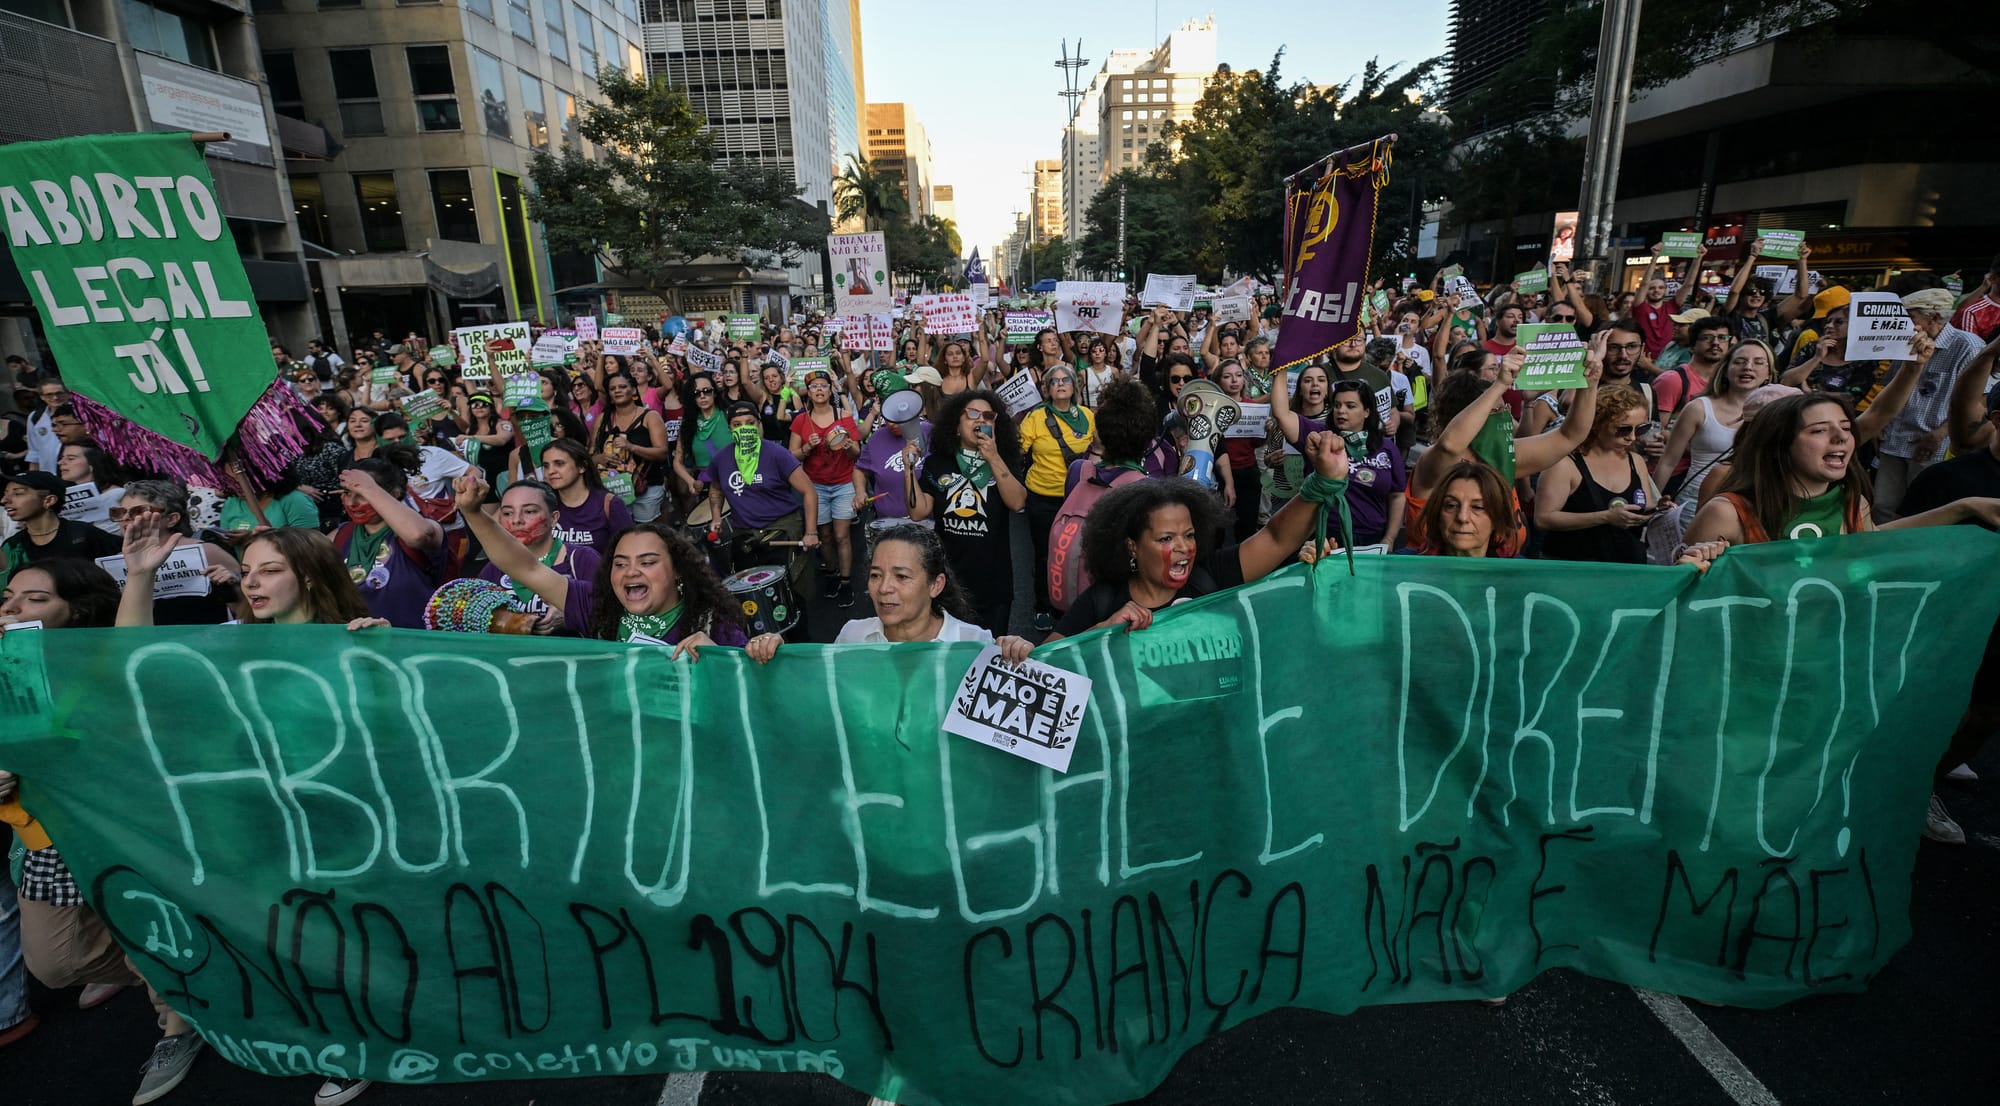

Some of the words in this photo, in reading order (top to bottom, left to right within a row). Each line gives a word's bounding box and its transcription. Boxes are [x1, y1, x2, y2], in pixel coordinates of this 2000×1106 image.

[0, 172, 222, 247] ABORTO
[1713, 236, 1737, 246] JUCA
[31, 256, 252, 327] LEGAL
[1078, 307, 1100, 318] PAI
[1863, 304, 1901, 317] CRIANÇA
[1870, 318, 1879, 330] É
[1880, 319, 1908, 330] MÃE!
[493, 329, 500, 340] A
[503, 327, 527, 339] SUA
[1537, 333, 1552, 342] NÃO
[1526, 342, 1559, 350] GRAVIDEZ
[113, 327, 211, 394] JÁ!
[470, 355, 485, 366] DA
[1525, 352, 1583, 363] ESTUPRADOR
[1526, 364, 1547, 376] NÃO
[1547, 362, 1555, 375] É
[942, 517, 989, 533] LUANA
[173, 560, 187, 570] DA
[1049, 522, 1078, 601] adidas
[161, 569, 201, 581] INFANTIL
[1136, 639, 1195, 668] FORA
[1196, 632, 1243, 661] LIRA
[982, 671, 1037, 705] NÃO
[1041, 692, 1060, 715] É
[972, 692, 1055, 744] MÃE
[125, 642, 692, 906] ABORTO
[732, 632, 1203, 923] LEGAL
[1396, 576, 1941, 858] DIREITO!
[196, 887, 419, 1045] NÃO
[443, 881, 552, 1045] AO
[568, 902, 708, 1032] PL
[687, 904, 895, 1053] 1904
[963, 867, 1308, 1069] CRIANÇA
[1360, 836, 1497, 993] NÃO
[1647, 846, 1881, 988] MÃE!
